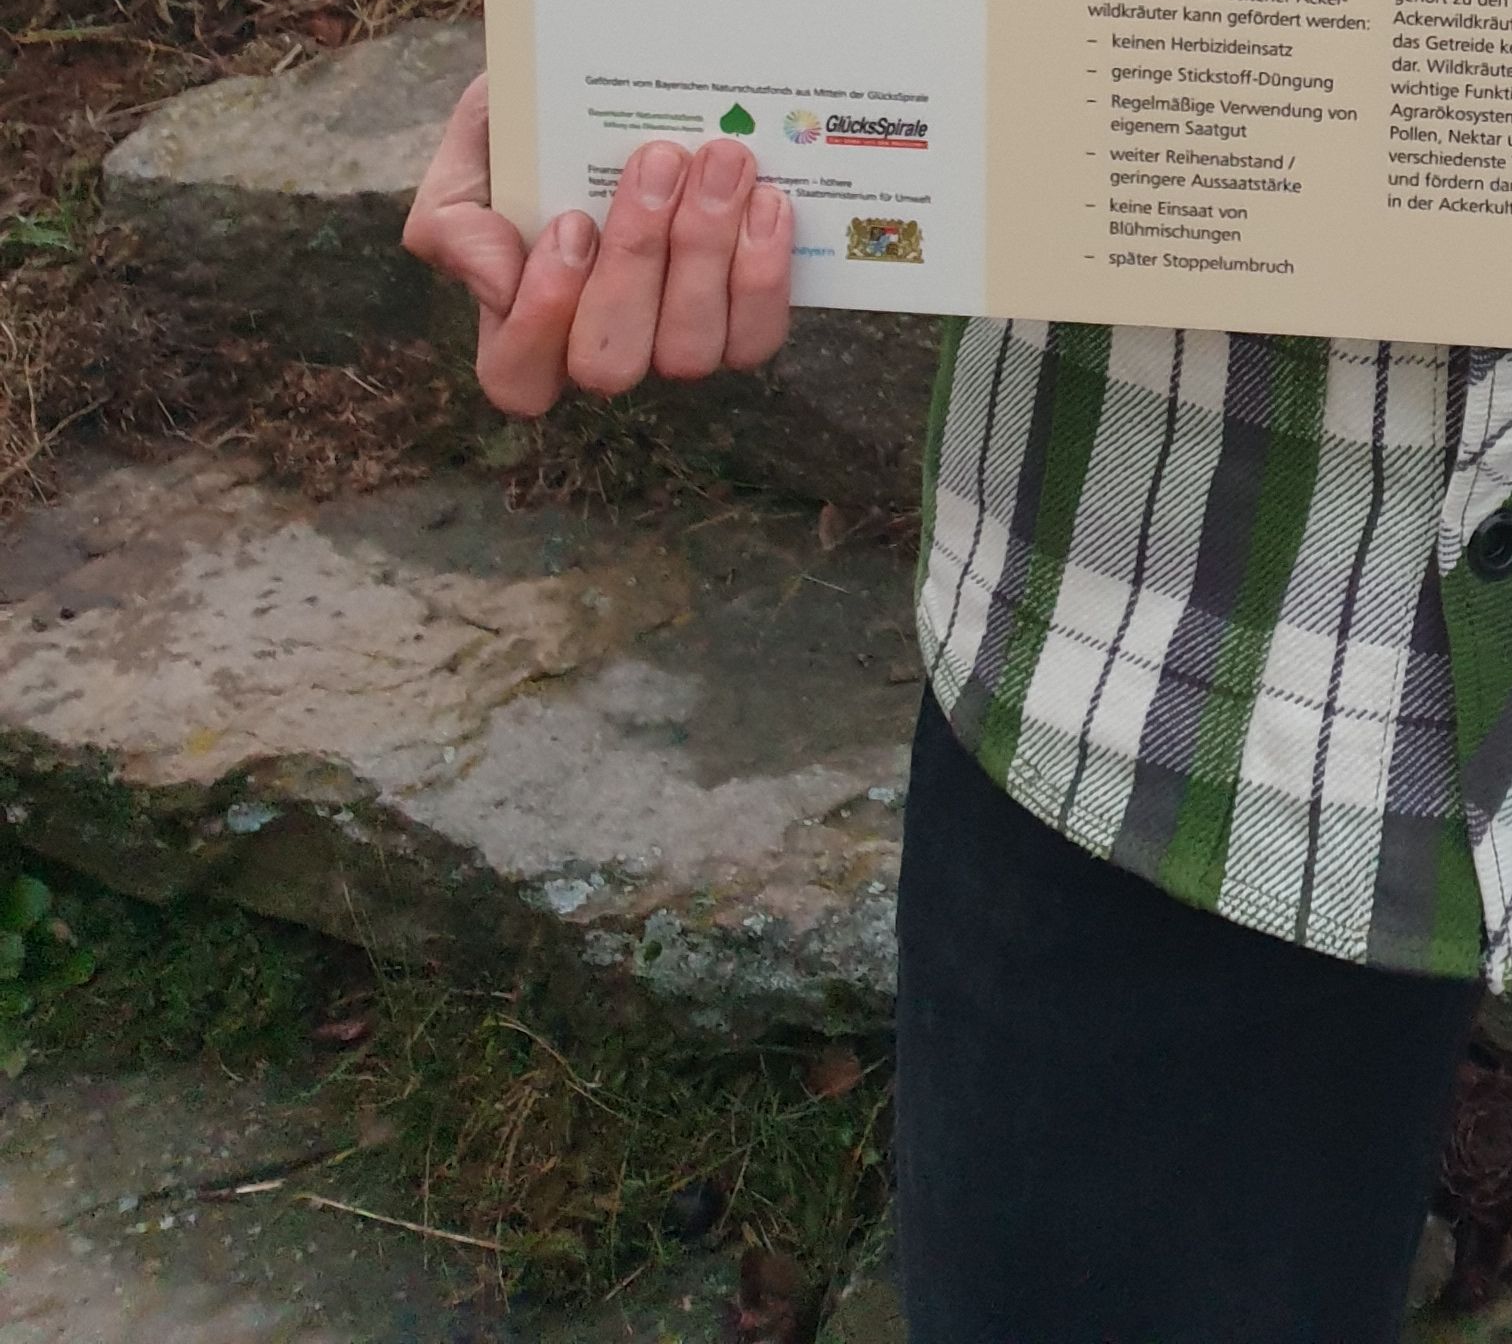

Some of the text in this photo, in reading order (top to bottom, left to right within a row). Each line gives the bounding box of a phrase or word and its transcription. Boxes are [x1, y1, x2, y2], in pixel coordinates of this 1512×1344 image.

[1087, 2, 1371, 31] wildkräuter kann gefördert werden:
[1112, 32, 1294, 58] keinen Herbizideinsatz
[1392, 33, 1421, 50] das
[1425, 35, 1496, 55] Getreide
[1391, 56, 1421, 73] dar.
[1111, 65, 1334, 94] geringe Stickstoff-Düngung
[1111, 93, 1358, 124] Regelmäßige Verwendung von
[825, 114, 929, 139] GlücksSpirale
[1110, 117, 1248, 142] eigenem Saatgut
[1109, 220, 1242, 245] Blühmischungen
